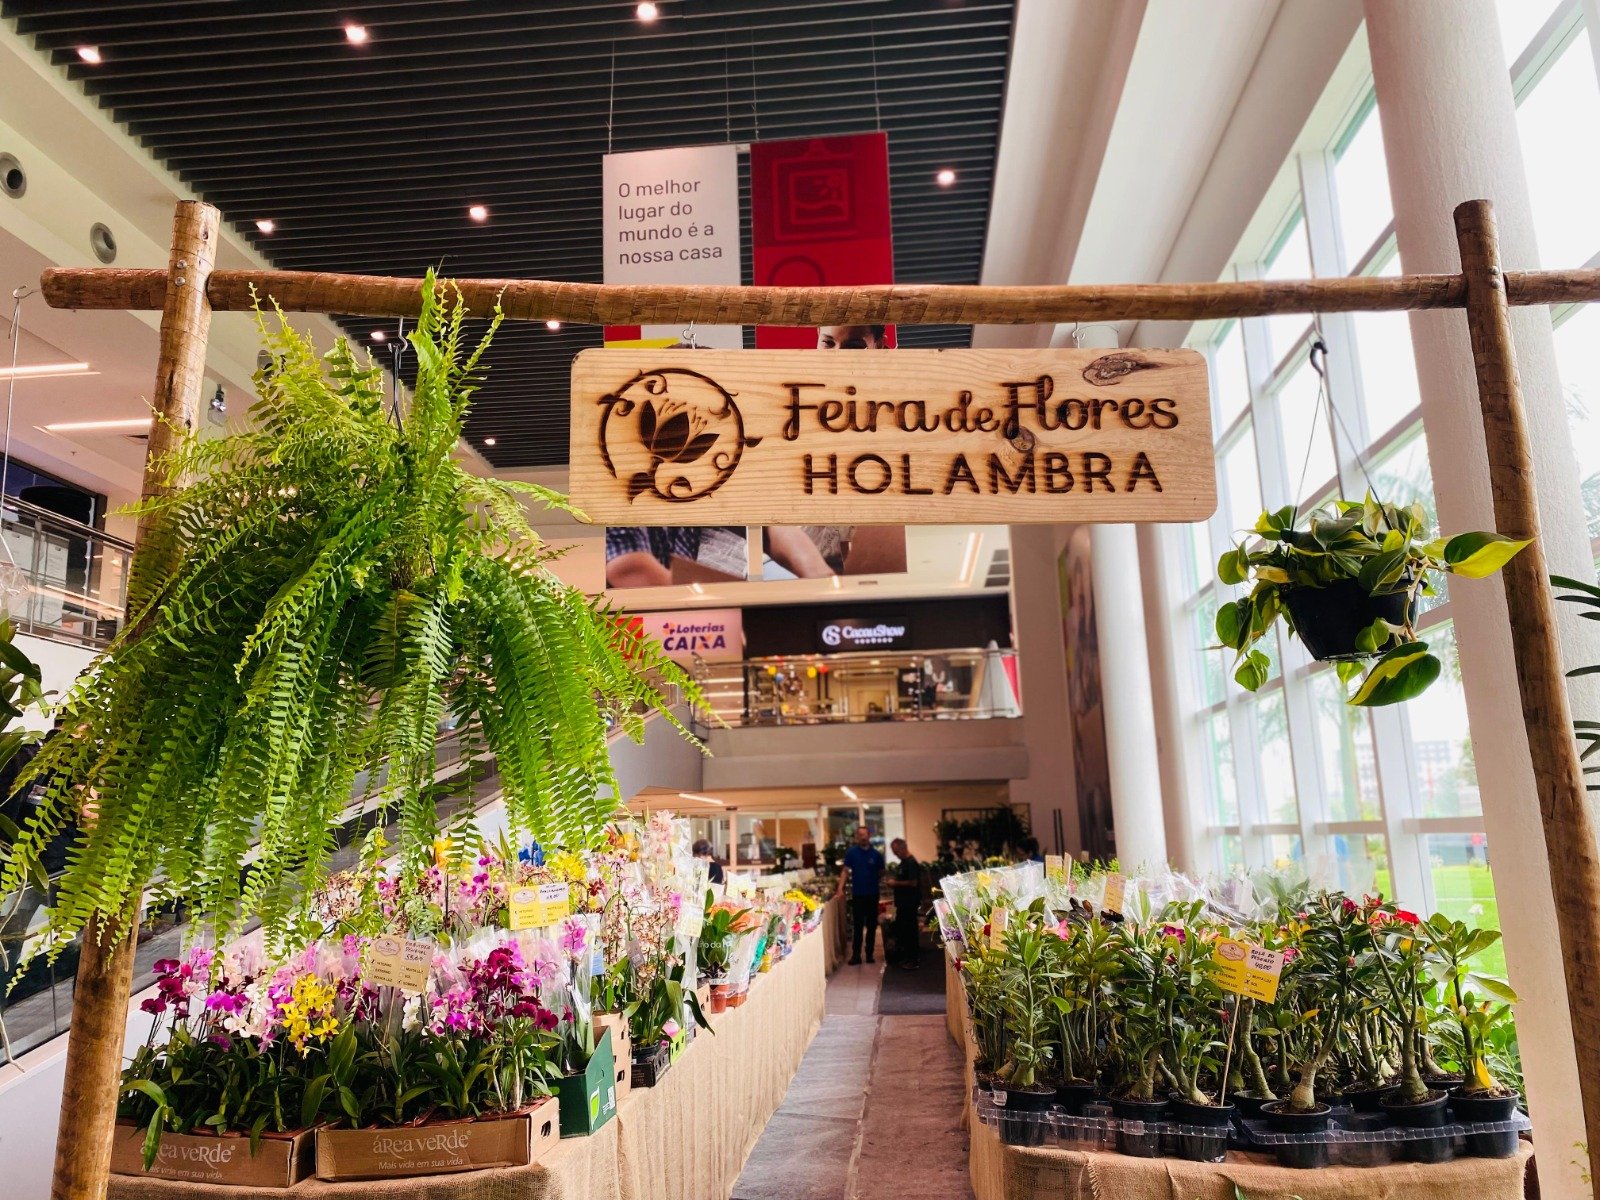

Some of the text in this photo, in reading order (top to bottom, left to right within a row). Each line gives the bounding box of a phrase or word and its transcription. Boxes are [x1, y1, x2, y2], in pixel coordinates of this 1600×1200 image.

[618, 179, 701, 198] O melhor
[618, 201, 693, 223] lugar do
[619, 222, 714, 242] mundo é a
[619, 246, 723, 265] nossa casa
[781, 374, 1179, 441] Feira de Flores
[803, 451, 1163, 495] HOLAMBRA
[676, 622, 725, 634] Loterias
[663, 634, 727, 652] CAIXA
[161, 1167, 177, 1176] vida
[177, 1169, 190, 1177] em
[191, 1171, 205, 1179] sua
[378, 1162, 397, 1171] Mais
[399, 1160, 414, 1169] vida
[431, 1160, 445, 1168] sua
